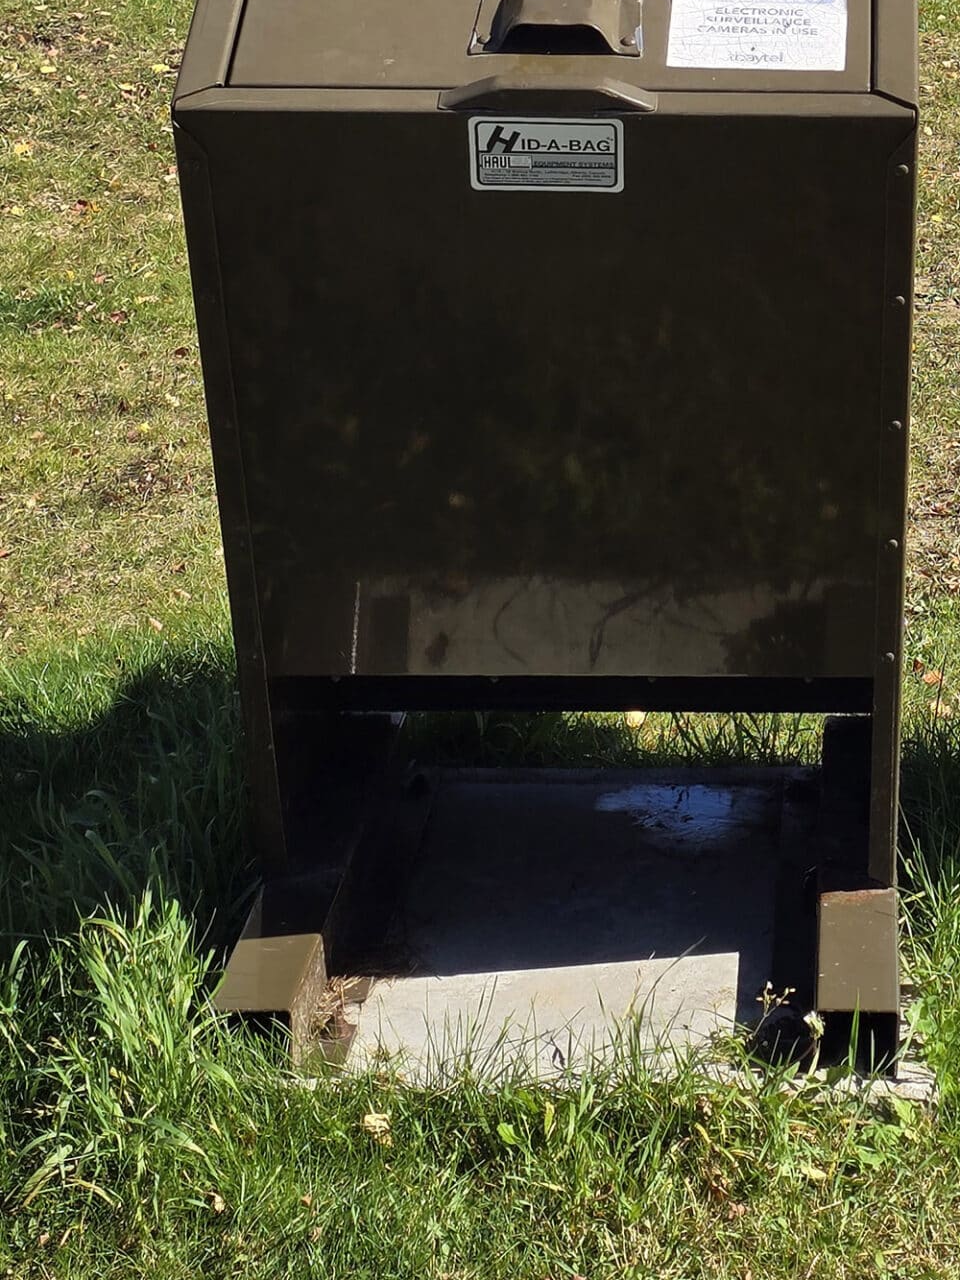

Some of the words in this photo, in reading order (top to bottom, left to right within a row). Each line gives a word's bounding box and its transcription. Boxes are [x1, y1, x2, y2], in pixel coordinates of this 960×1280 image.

[714, 7, 805, 17] ELECTRONIC
[706, 16, 812, 26] SURVEILLANCE
[697, 25, 768, 35] CAMERAS
[771, 27, 787, 35] IN
[791, 27, 819, 36] USE
